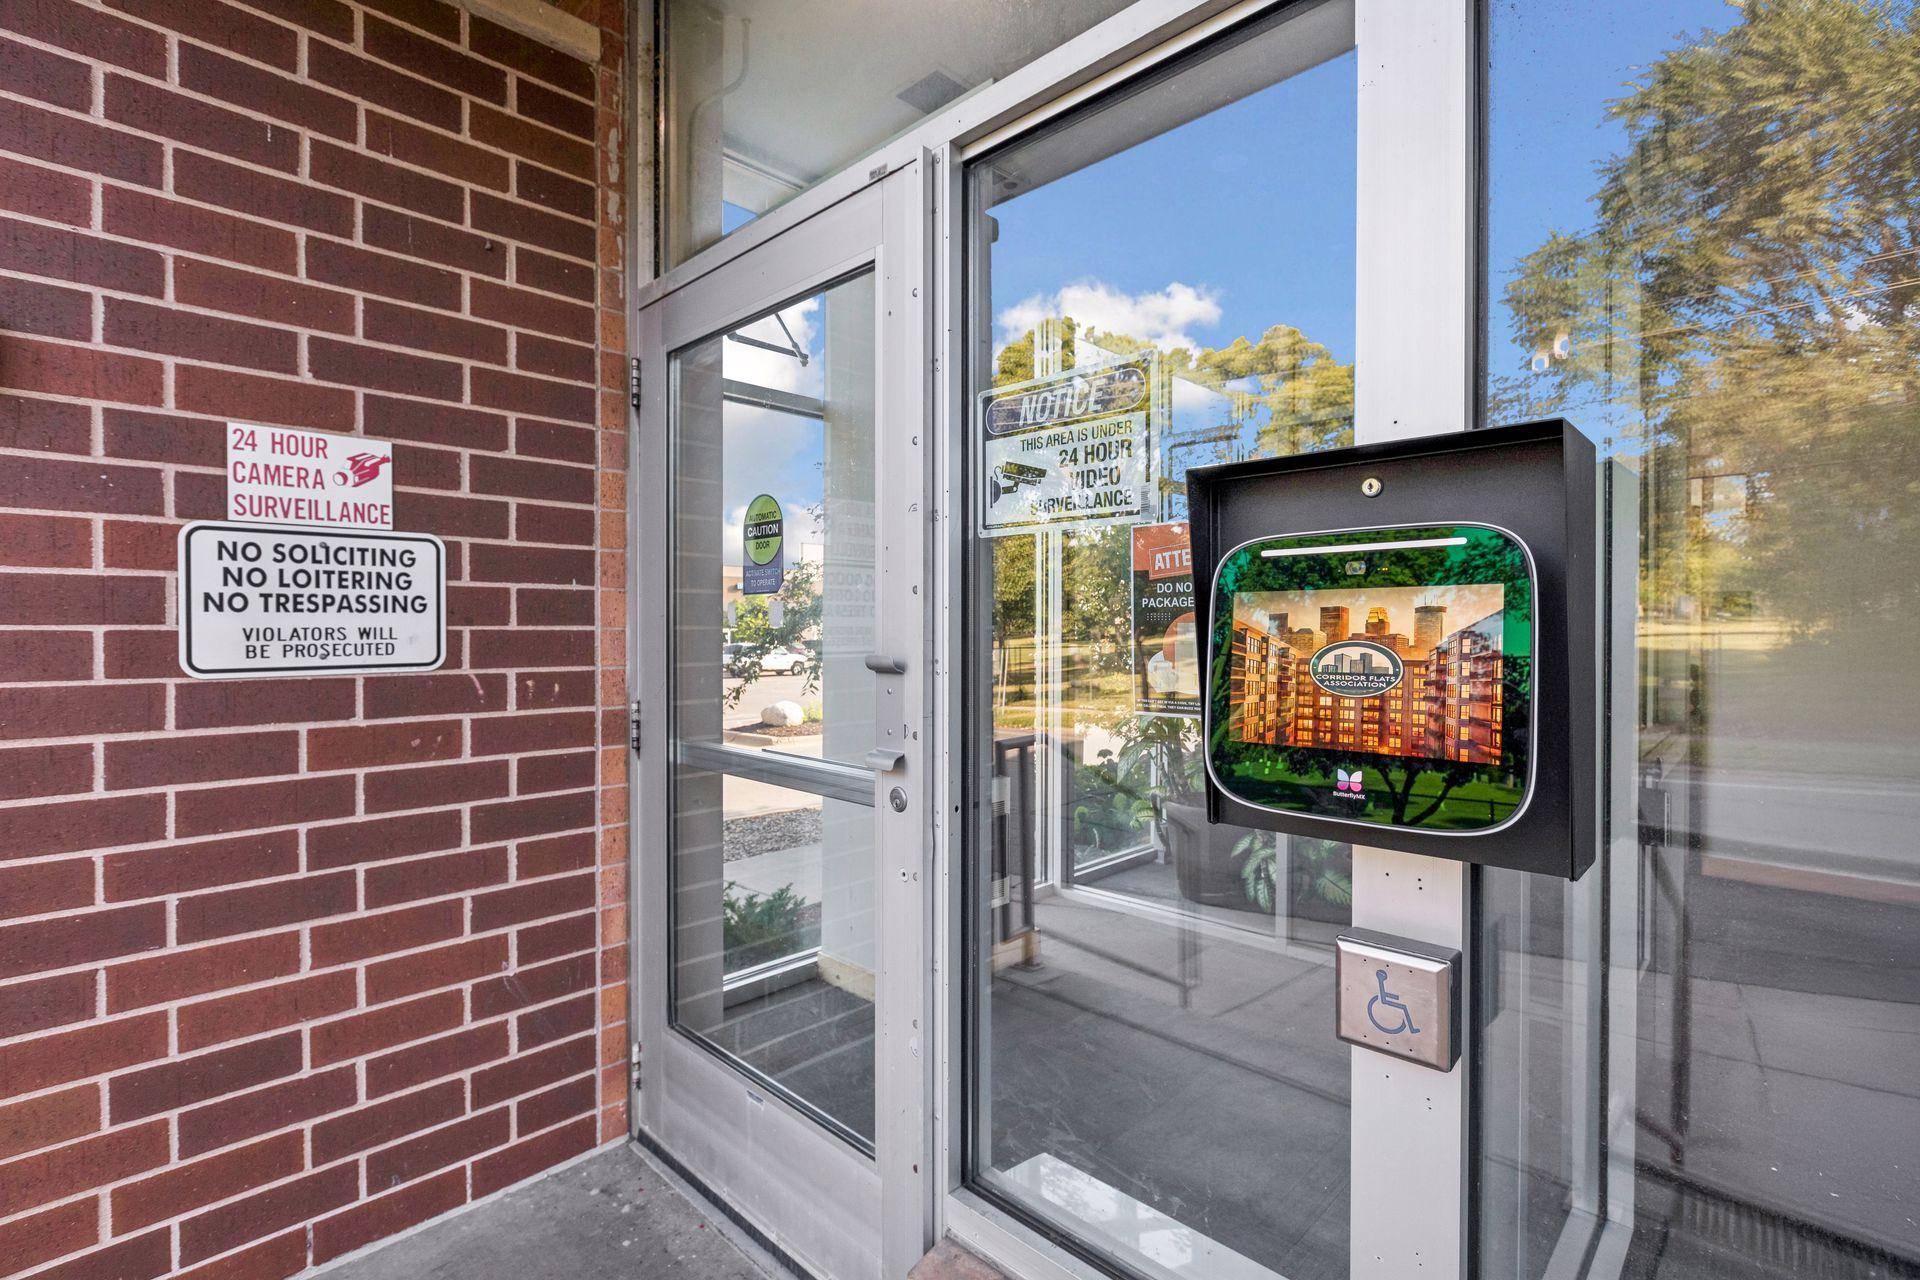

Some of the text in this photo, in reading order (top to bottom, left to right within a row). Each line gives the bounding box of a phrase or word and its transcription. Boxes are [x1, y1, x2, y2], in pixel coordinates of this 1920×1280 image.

[1018, 378, 1105, 426] NOTICE
[232, 428, 328, 459] 24 HOUR
[1020, 420, 1132, 452] THIS AREA IS UNDER
[1058, 438, 1132, 468] 24 HOUR
[232, 461, 326, 490] CAMERA
[1068, 465, 1121, 491] VIDEO
[233, 494, 391, 525] SURVEILLANCE
[748, 511, 777, 521] AUTOMATIC
[747, 524, 779, 537] CAUTION
[217, 540, 416, 567] NO SOLICITING
[755, 540, 770, 550] DOOR
[1155, 549, 1191, 570] ATTE
[222, 567, 412, 590] NO LOITERING
[1157, 582, 1193, 593] DO NO
[203, 592, 428, 614] NO TRESPASSING
[1142, 596, 1195, 608] PACKAGE
[242, 627, 398, 642] VIOLATORS WILL
[245, 643, 395, 659] BE PROSECUTED
[1323, 680, 1386, 688] ASSOCIATION
[1333, 791, 1366, 799] ButterflyMX
